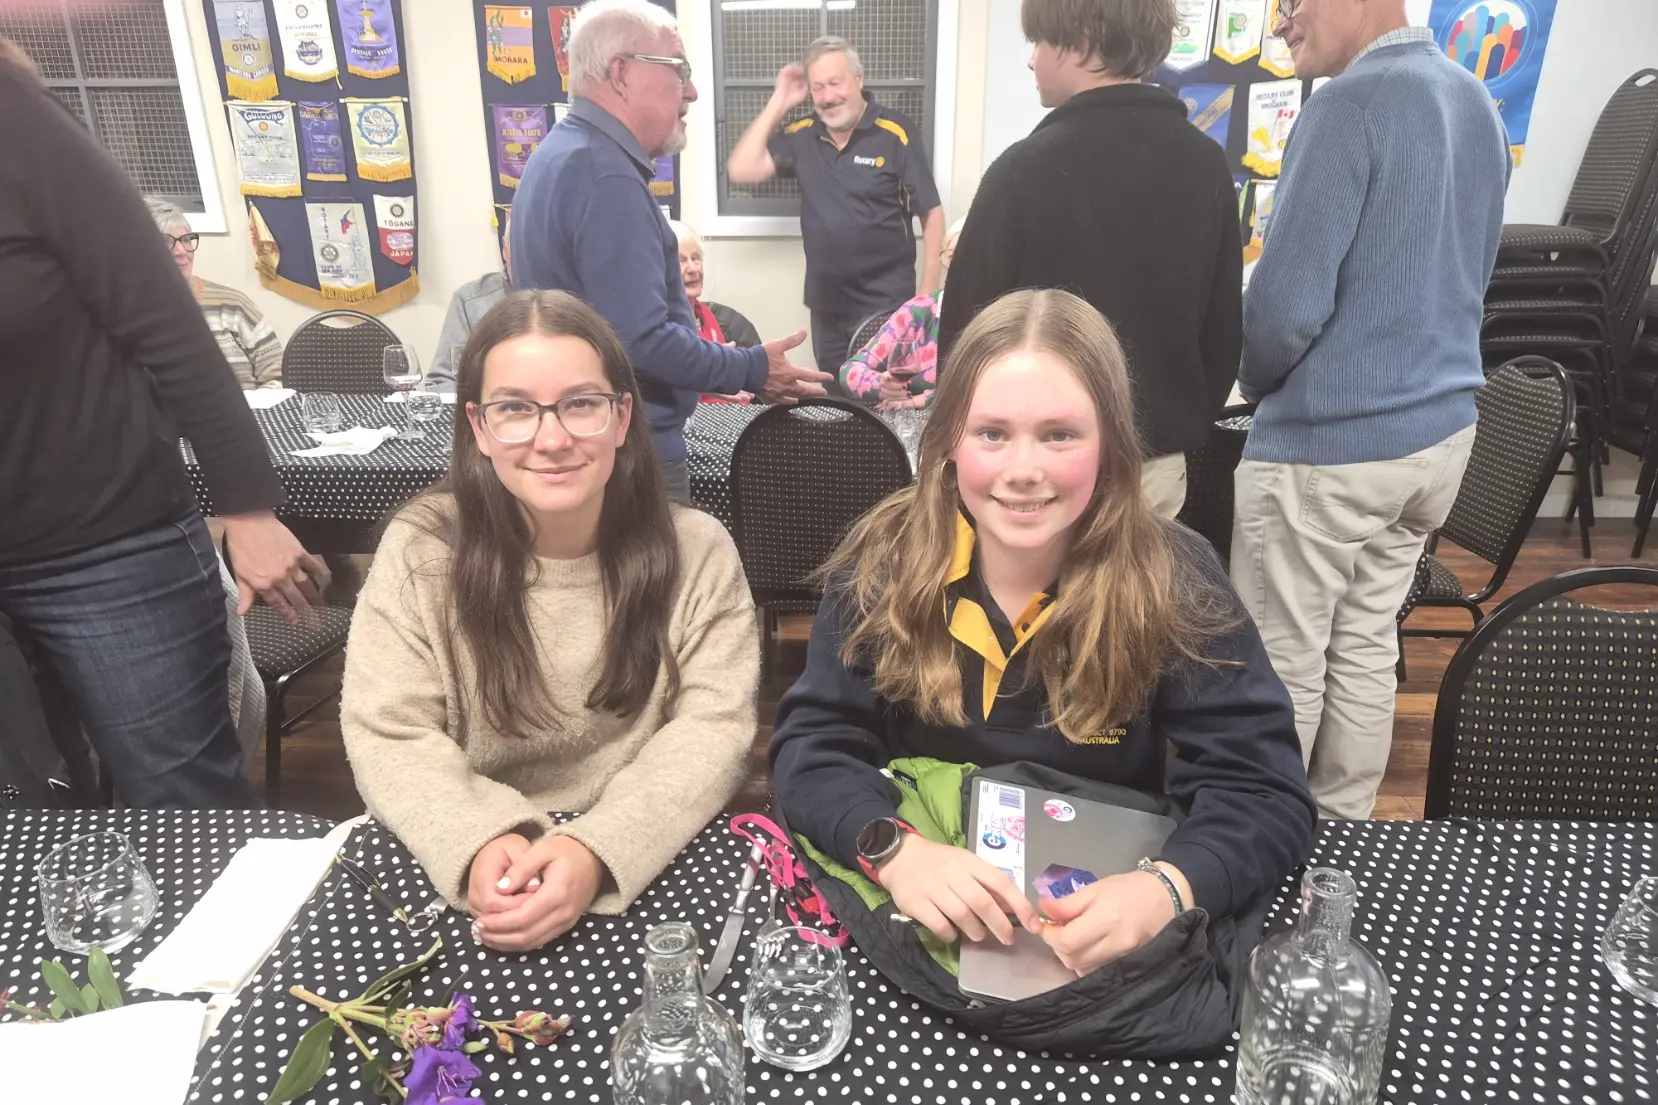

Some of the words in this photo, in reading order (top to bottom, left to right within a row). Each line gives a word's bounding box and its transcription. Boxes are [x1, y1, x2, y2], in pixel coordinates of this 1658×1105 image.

[231, 43, 261, 52] GIMLI
[494, 56, 529, 64] MOBARA
[854, 155, 876, 166] Rotary
